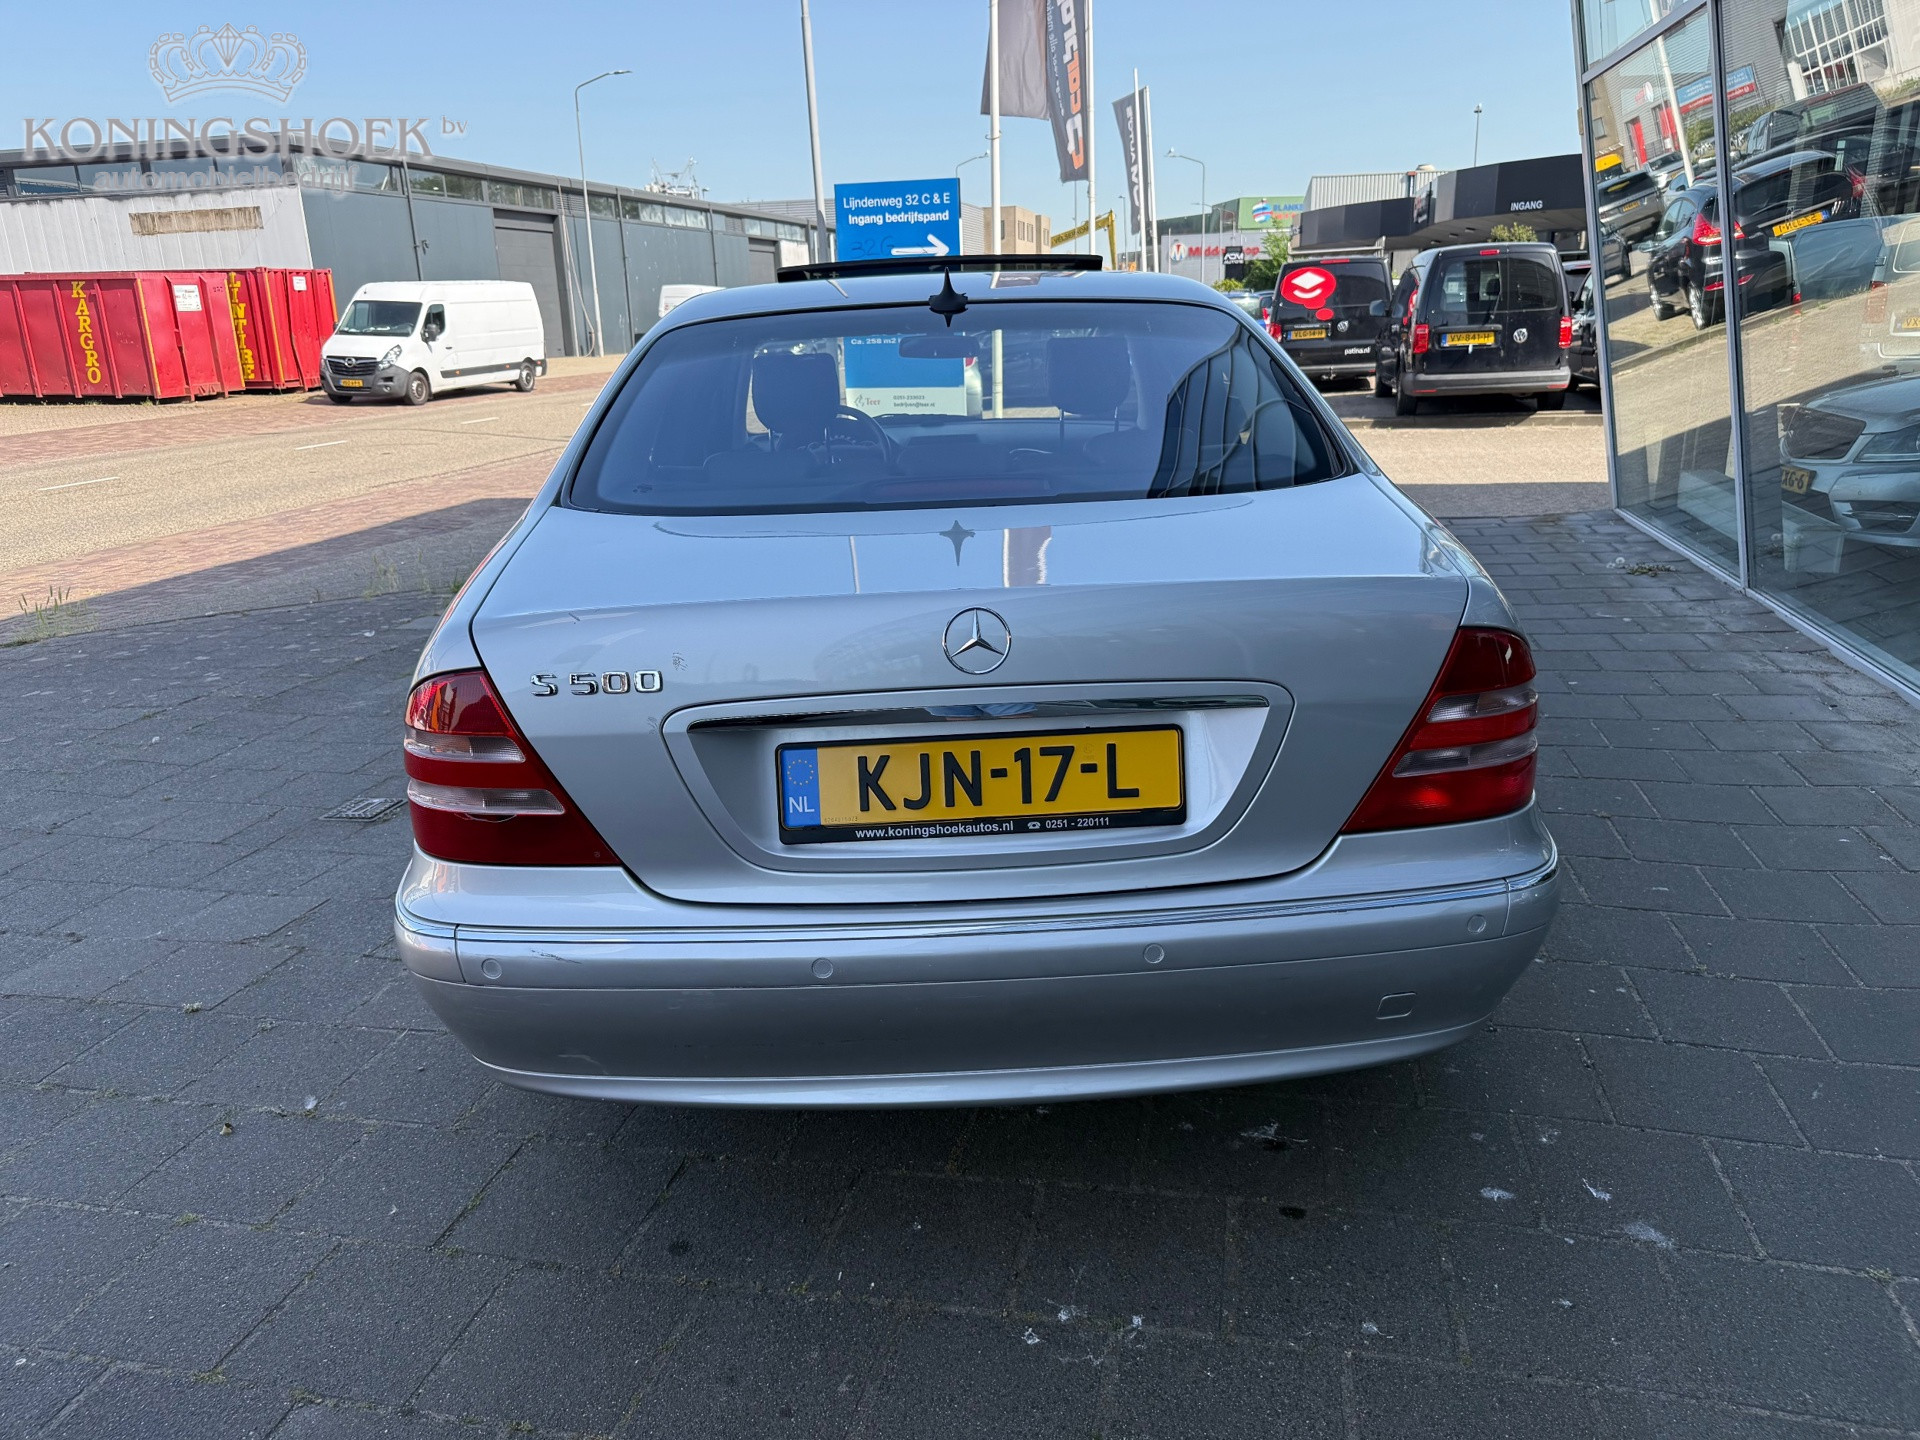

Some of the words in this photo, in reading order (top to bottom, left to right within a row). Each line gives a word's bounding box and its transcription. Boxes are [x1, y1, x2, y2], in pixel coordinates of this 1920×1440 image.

[843, 196, 903, 211] Lijndenweg
[905, 194, 919, 206] 32
[921, 193, 931, 205] C
[932, 192, 941, 204] &
[943, 192, 951, 204] E
[1510, 199, 1544, 211] INGANG
[848, 214, 884, 227] Ingang
[885, 210, 950, 225] bedrijfspand
[71, 281, 102, 384] KARGRO
[883, 337, 897, 345] m2
[1344, 346, 1371, 356] patina.nl
[530, 672, 559, 697] S
[569, 670, 664, 696] 500
[856, 743, 1141, 812] KJN-17-L
[788, 795, 815, 814] NL
[855, 820, 1014, 839] www.koningshoekautos.nl
[1045, 819, 1068, 829] 0251
[1077, 816, 1110, 828] 220111
